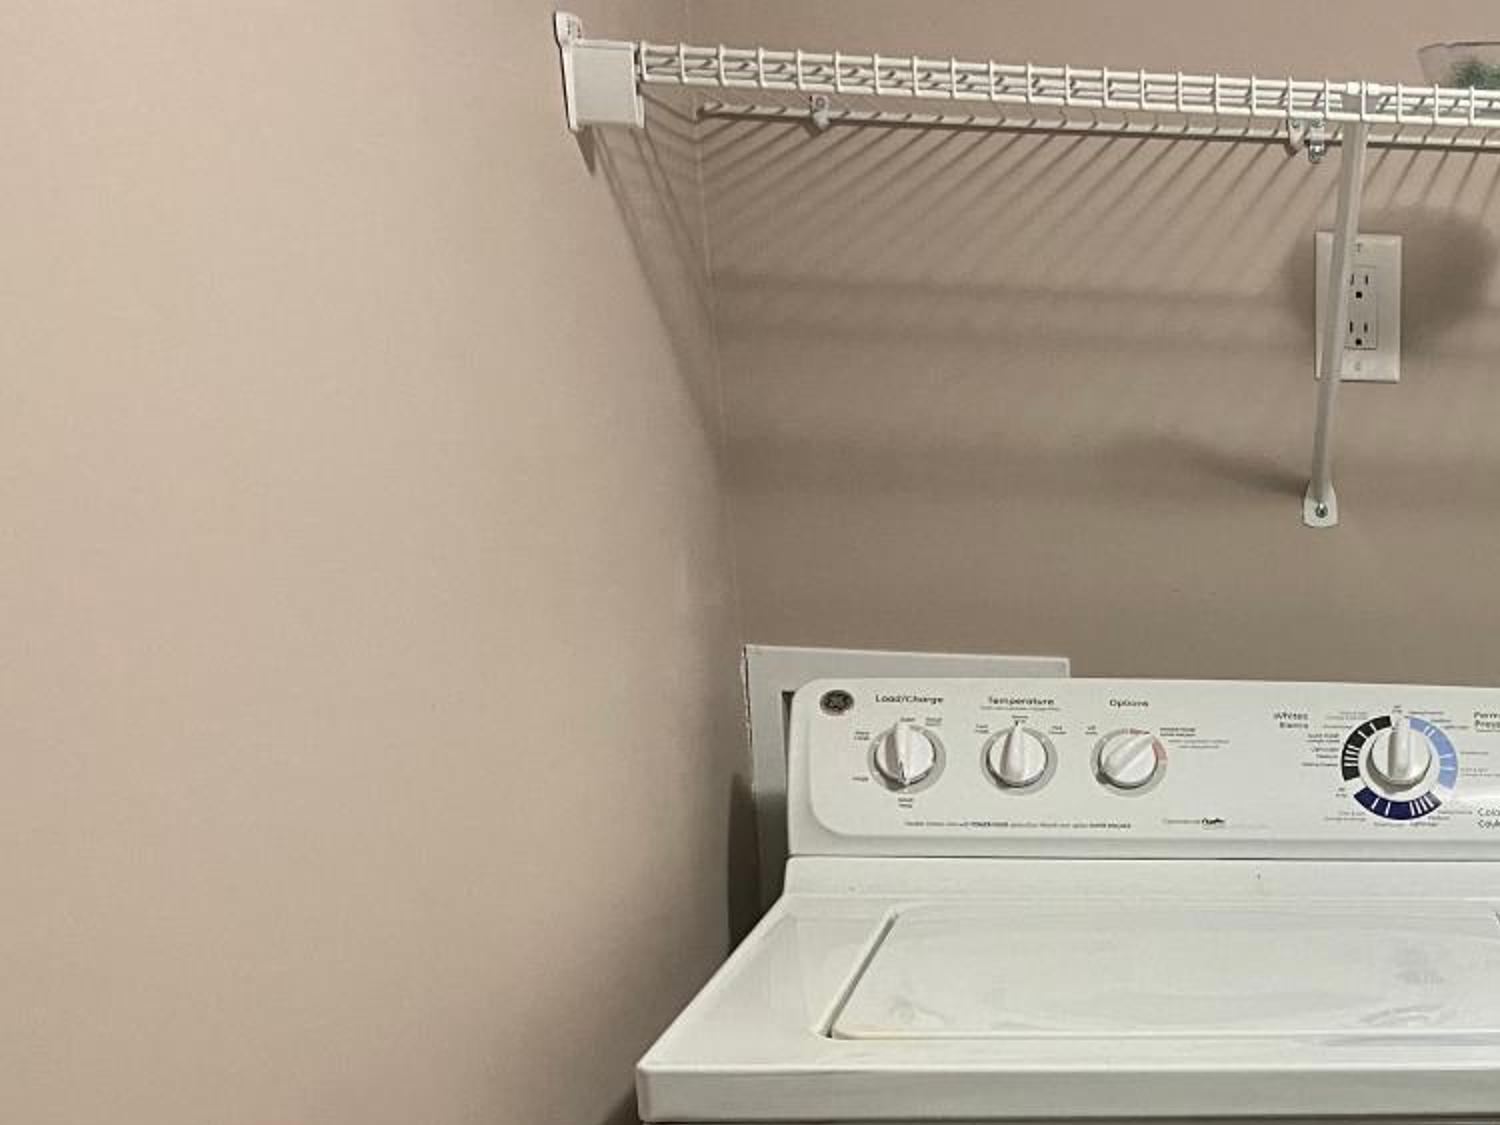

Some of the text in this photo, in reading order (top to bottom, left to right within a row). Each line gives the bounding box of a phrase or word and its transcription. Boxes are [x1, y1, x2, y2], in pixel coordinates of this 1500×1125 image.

[875, 694, 944, 704] Load/Charge
[988, 696, 1055, 706] Temperature
[1109, 698, 1150, 708] Options
[1273, 711, 1309, 720] Whites
